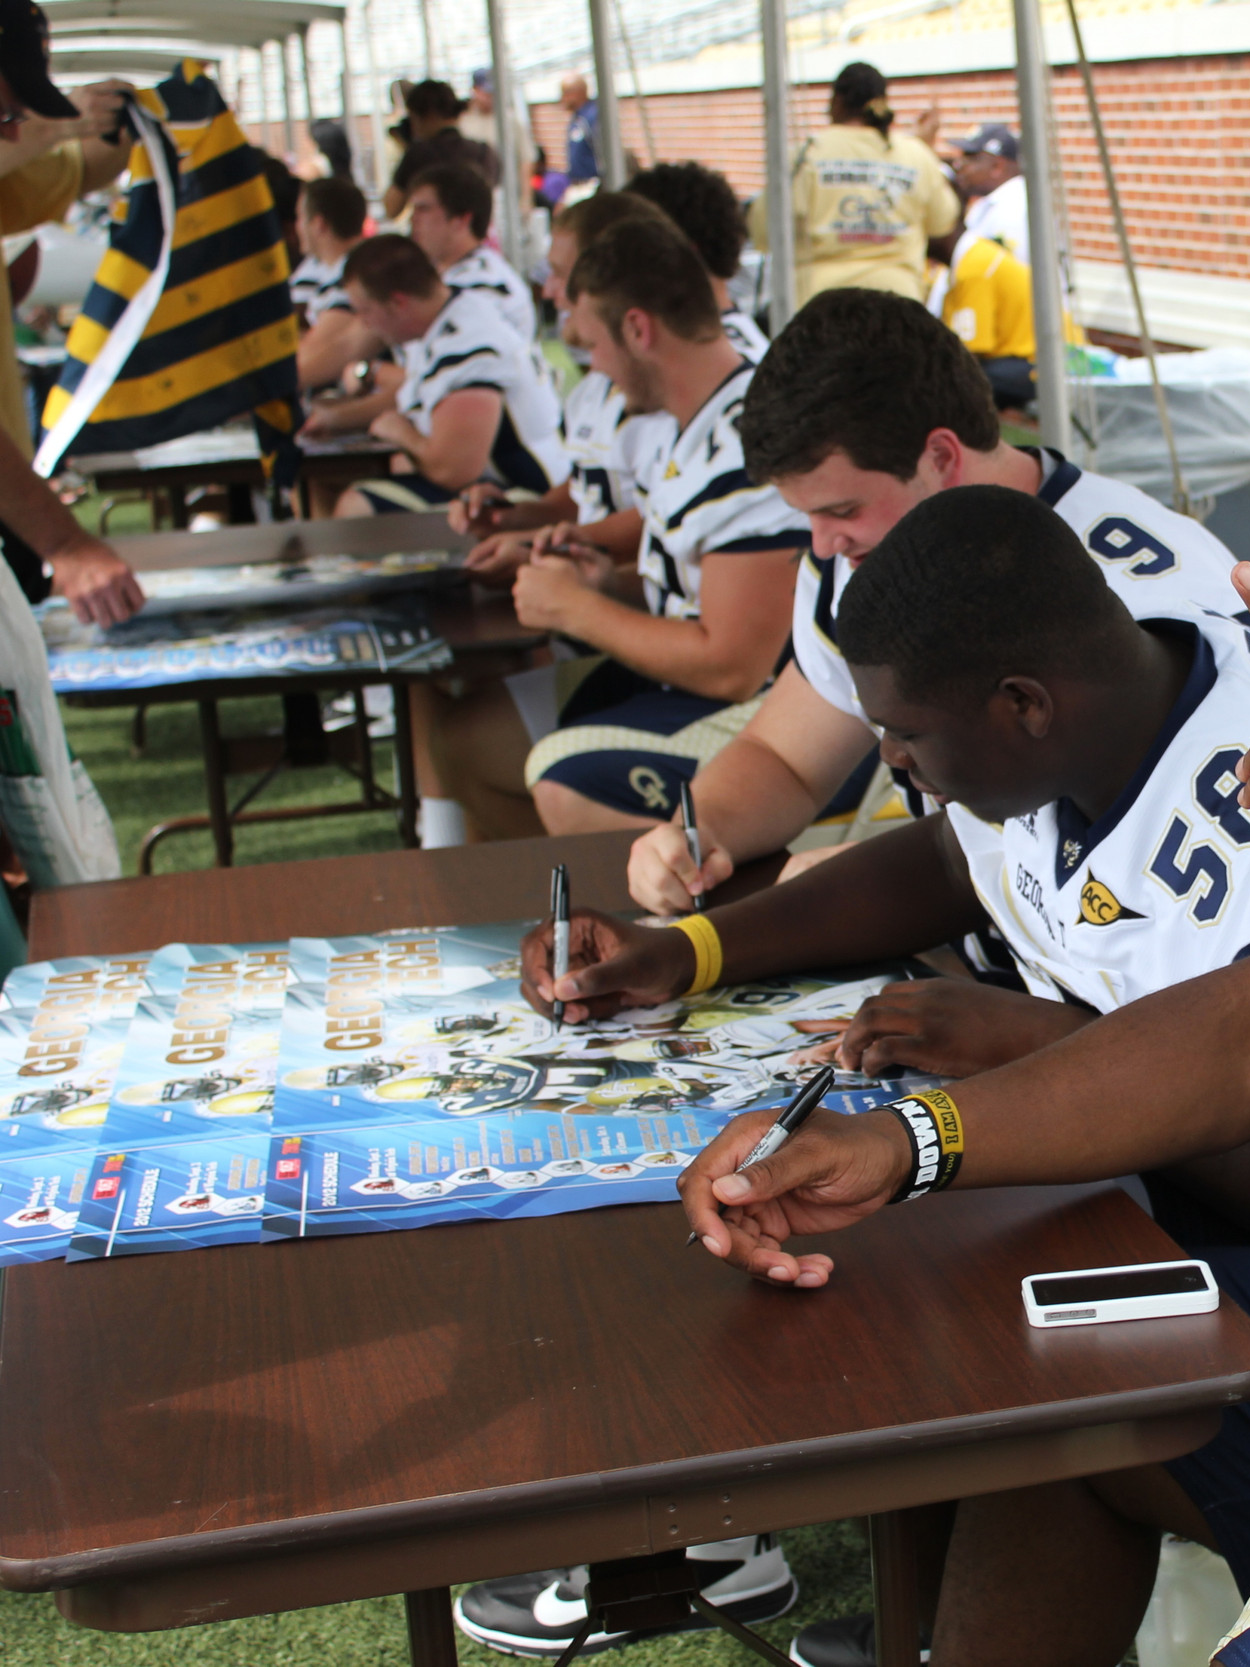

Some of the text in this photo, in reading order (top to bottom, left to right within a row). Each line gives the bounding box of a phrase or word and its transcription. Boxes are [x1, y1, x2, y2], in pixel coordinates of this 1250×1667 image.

[1082, 886, 1112, 921] ACC
[241, 951, 289, 1002] ECH
[324, 950, 383, 1051] GEORGIA
[18, 969, 101, 1077] GEORGIA
[166, 960, 240, 1065] GEORGIA
[892, 1099, 939, 1185] DOWN
[941, 1111, 958, 1132] AM
[945, 1134, 958, 1144] I
[322, 1152, 340, 1188] SCHEDULE
